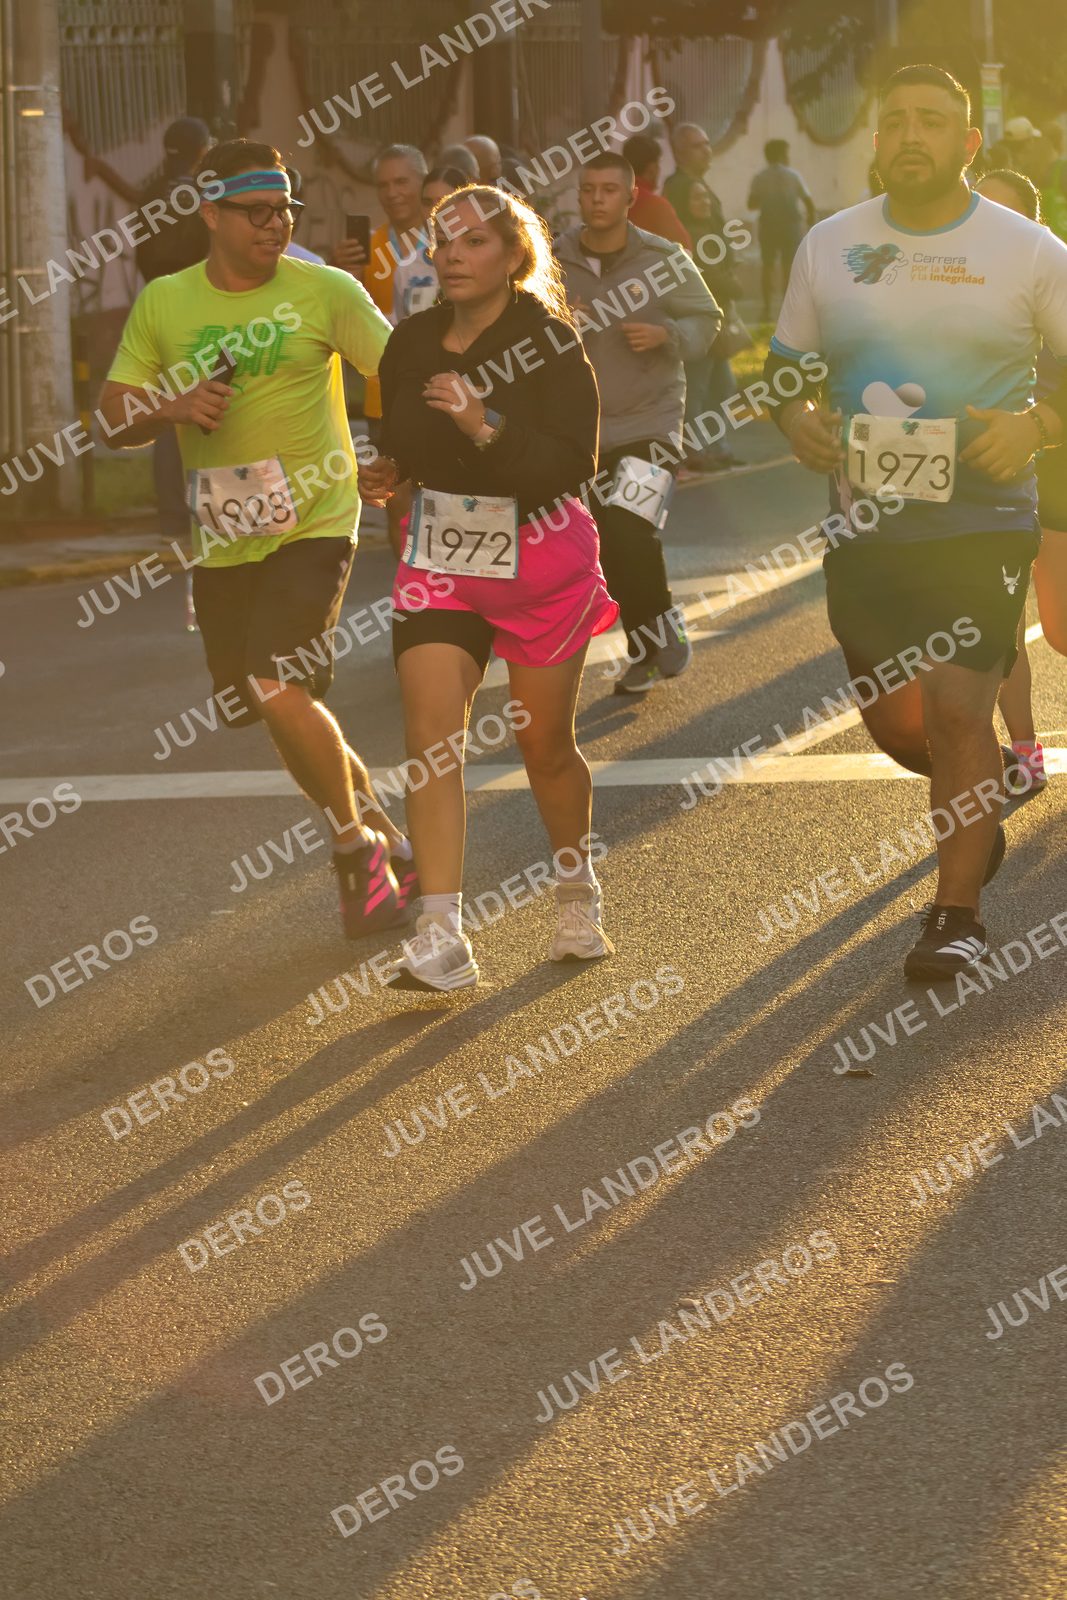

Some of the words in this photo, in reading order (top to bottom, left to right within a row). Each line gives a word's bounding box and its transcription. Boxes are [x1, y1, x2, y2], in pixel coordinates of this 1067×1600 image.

[912, 252, 967, 265] Carrera
[943, 265, 967, 274] Vida
[930, 273, 985, 285] Integridad
[855, 449, 951, 491] 1973
[202, 491, 291, 530] 1928
[425, 524, 512, 567] 1972
